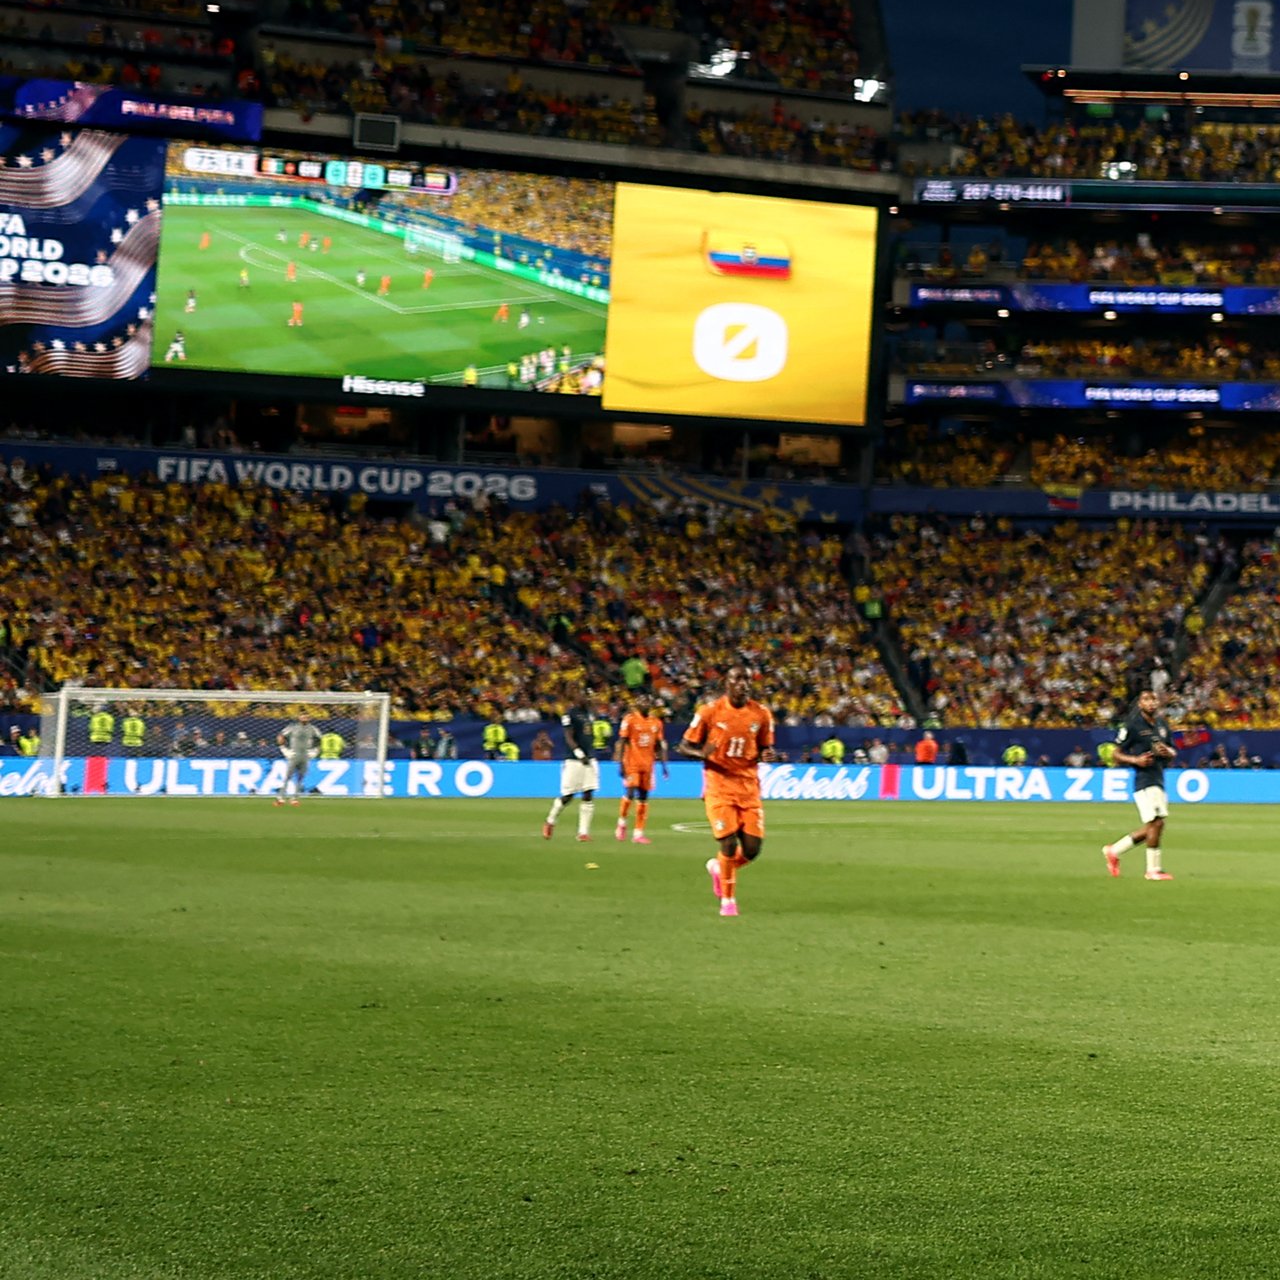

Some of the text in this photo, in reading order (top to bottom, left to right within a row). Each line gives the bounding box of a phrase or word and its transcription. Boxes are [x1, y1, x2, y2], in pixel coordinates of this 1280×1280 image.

[21, 260, 115, 288] 2026
[342, 375, 425, 398] Hisense
[157, 456, 537, 500] FIFA WORLD CUP 2026
[727, 736, 745, 757] 11
[125, 761, 298, 795] ULTRA
[317, 762, 495, 796] ZERO
[912, 766, 1053, 799] ULTRA
[1064, 768, 1210, 801] ZEO
